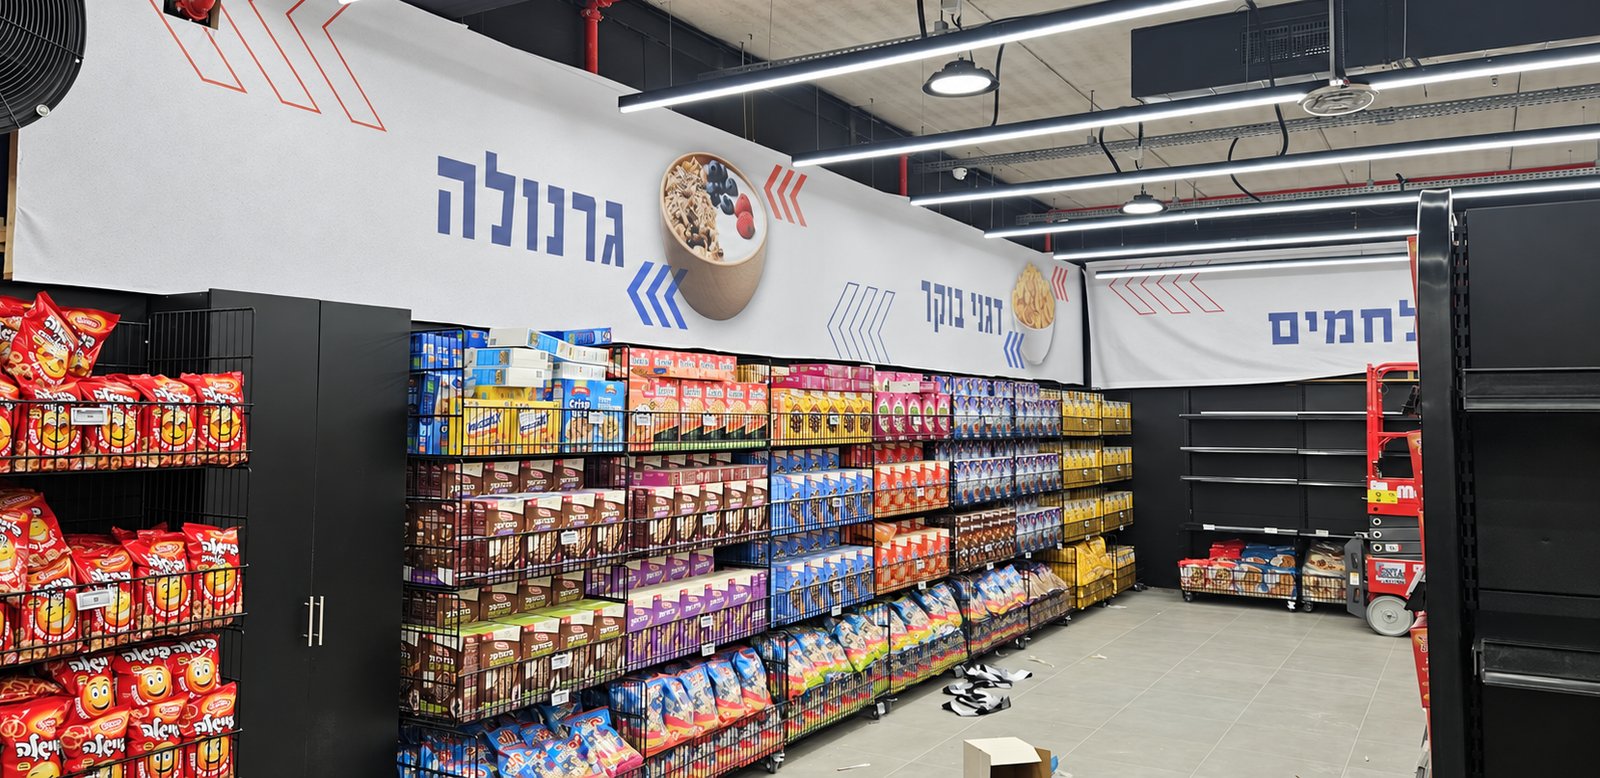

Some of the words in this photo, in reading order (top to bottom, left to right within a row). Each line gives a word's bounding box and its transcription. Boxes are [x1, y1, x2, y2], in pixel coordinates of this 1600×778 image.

[437, 150, 624, 268] גרנולה
[921, 280, 965, 333] בוקר
[971, 292, 1003, 336] דגני
[1268, 300, 1417, 345] לחמים
[569, 398, 590, 410] Crisp
